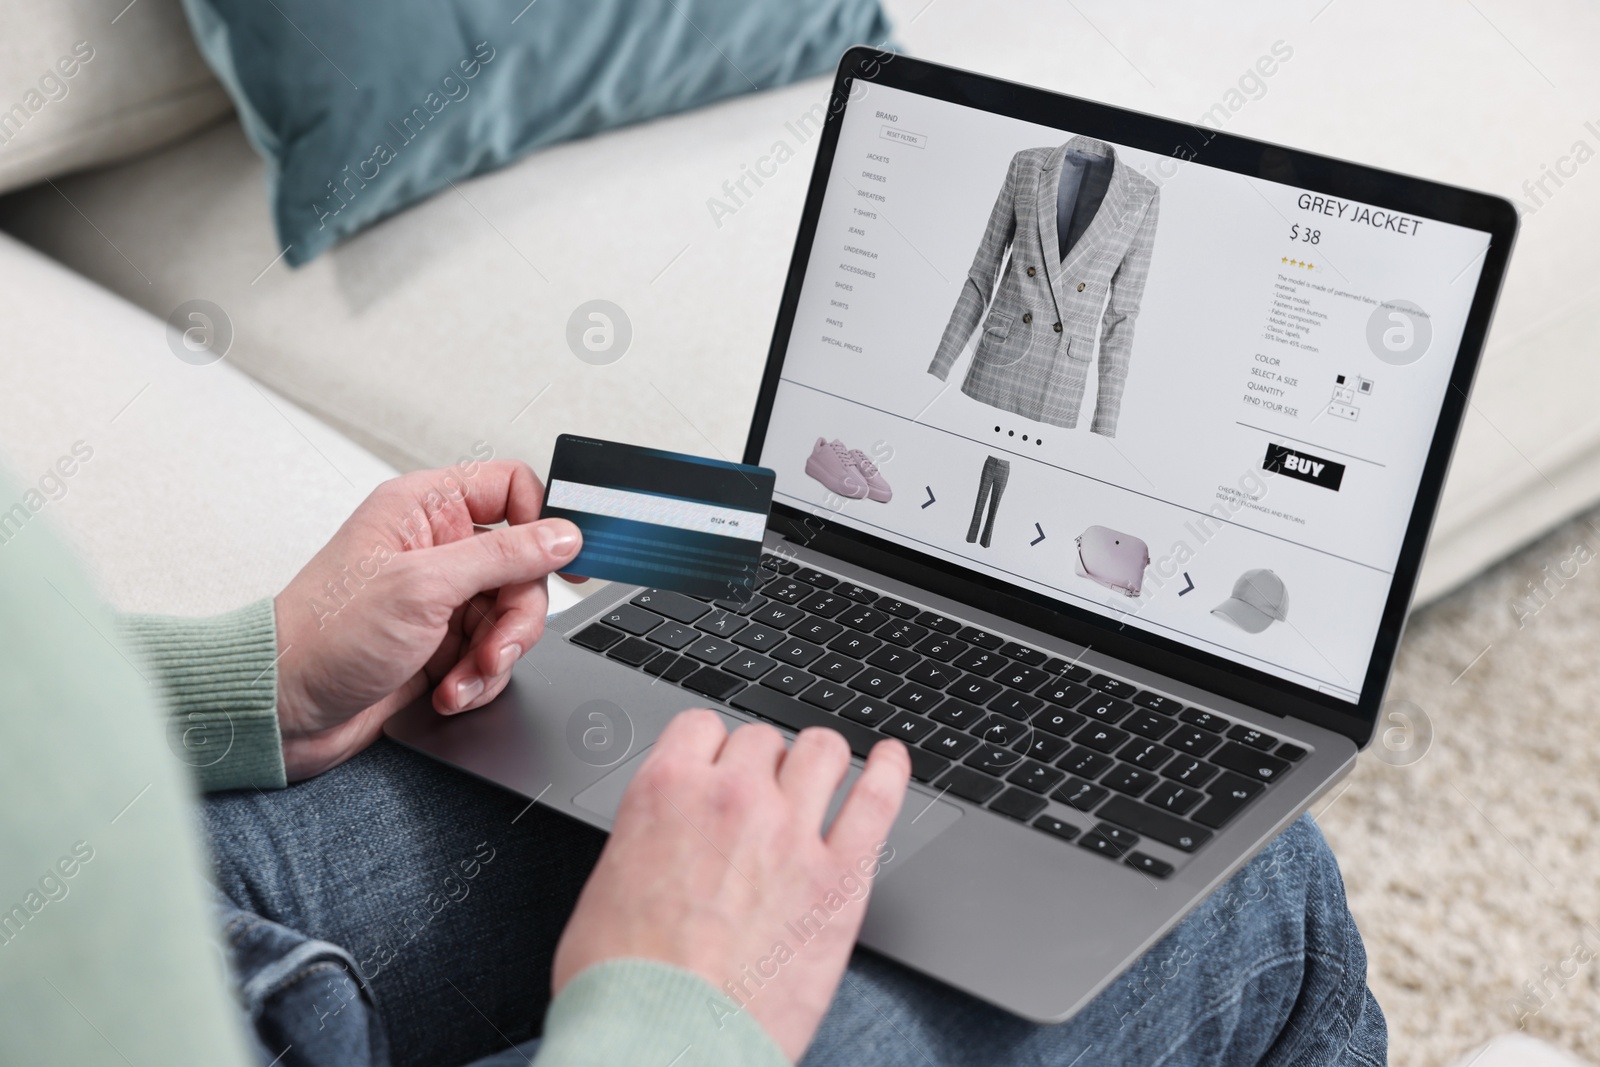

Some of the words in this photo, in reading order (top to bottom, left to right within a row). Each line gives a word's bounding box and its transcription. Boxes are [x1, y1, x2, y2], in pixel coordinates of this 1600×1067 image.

[876, 110, 898, 122] BRAND
[886, 130, 900, 139] RESET
[901, 134, 918, 143] FILTERS
[866, 153, 890, 164] JACKETS
[862, 171, 886, 183] DRESSES
[857, 190, 886, 202] SWEATERS
[853, 208, 877, 220] T-SHIRTS
[1298, 193, 1349, 218] GREY
[1350, 206, 1423, 236] JACKET
[848, 226, 865, 236] JEANS
[1290, 223, 1300, 241] $
[1302, 227, 1321, 245] 38
[844, 245, 878, 260] UNDERWEAR
[839, 264, 876, 278] ACCESSORIES
[834, 282, 853, 292] SHOES
[1278, 274, 1288, 282] The
[1288, 278, 1306, 286] model
[1311, 284, 1326, 292] made
[1276, 292, 1292, 301] Loose
[830, 300, 849, 310] SKIRTS
[1294, 306, 1306, 314] with
[1272, 308, 1288, 318] Fabric
[826, 318, 844, 328] PANTS
[822, 336, 842, 348] SPECIAL
[844, 342, 863, 354] PRICES
[1276, 336, 1288, 344] linen
[1254, 354, 1280, 366] COLOR
[1250, 367, 1276, 380] SELECT
[1284, 376, 1298, 387] SIZE
[1247, 382, 1286, 398] QUANTITY
[1243, 394, 1260, 406] FIND
[1262, 400, 1282, 412] YOUR
[1284, 406, 1298, 417] SIZE
[1284, 454, 1325, 478] BUY
[715, 620, 726, 628] A
[902, 722, 914, 730] N
[993, 725, 1004, 733] K
[943, 738, 957, 747] M
[1036, 741, 1043, 749] L
